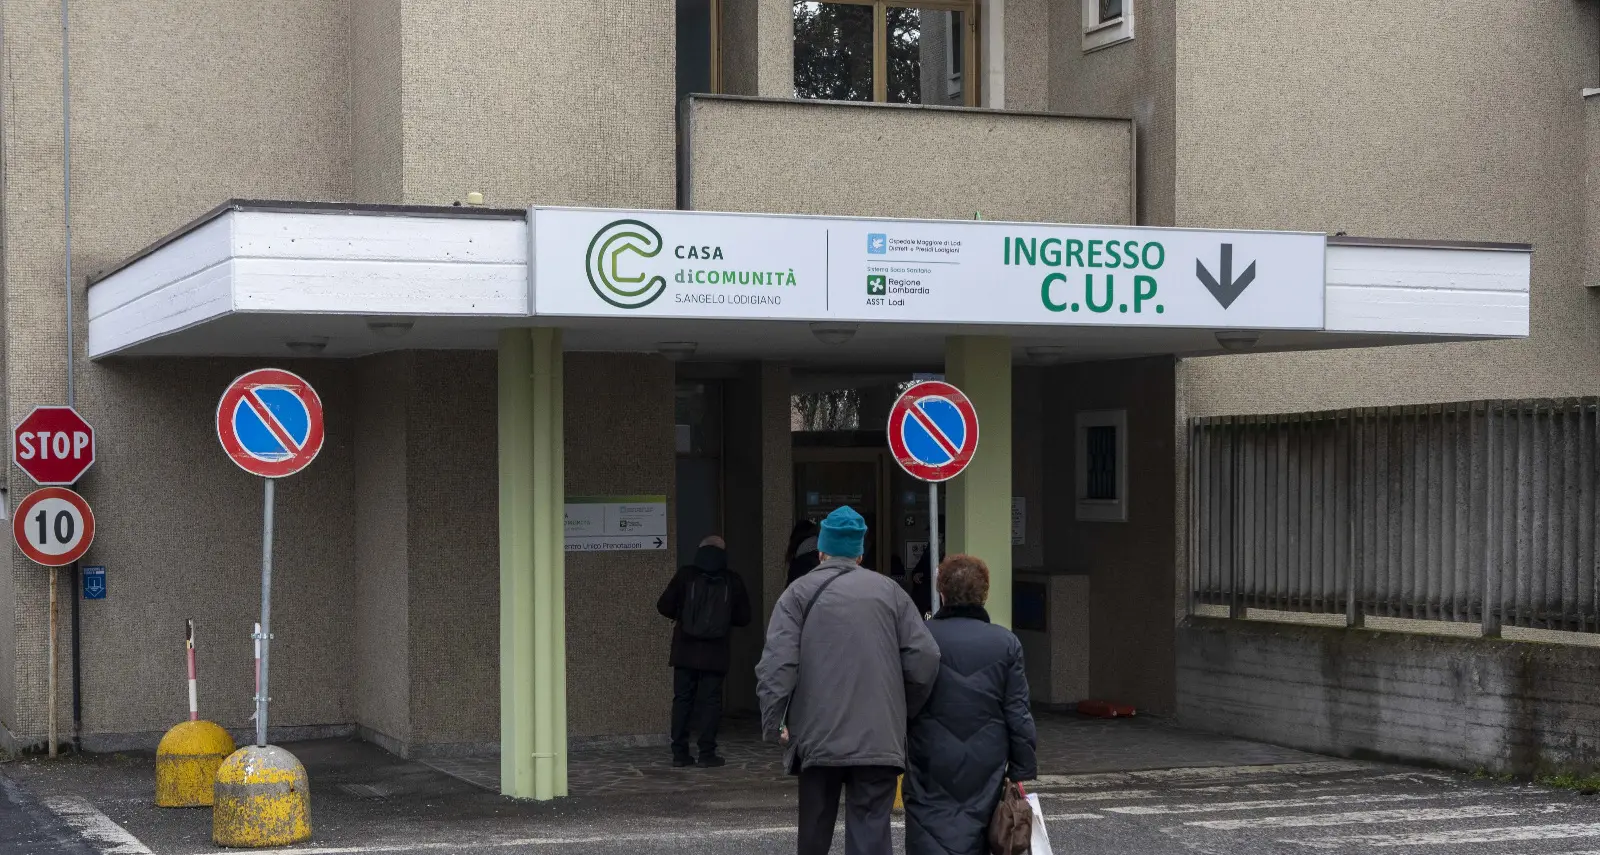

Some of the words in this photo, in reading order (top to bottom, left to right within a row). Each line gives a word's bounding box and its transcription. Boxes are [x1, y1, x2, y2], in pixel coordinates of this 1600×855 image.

[888, 238, 916, 246] Ospedale
[916, 239, 942, 247] Maggiore
[674, 245, 724, 260] CASA
[1004, 236, 1165, 270] INGRESSO
[674, 268, 797, 286] diCOMUNITÀ
[888, 278, 921, 287] Regione
[888, 286, 930, 295] Lombardia
[1040, 272, 1165, 314] C.U.P.
[675, 293, 725, 304] S.ANGELO
[727, 295, 781, 305] LODIGIANO
[866, 298, 885, 306] ASST
[888, 298, 905, 306] Lodi
[19, 431, 89, 460] STOP
[35, 510, 75, 545] 10
[564, 542, 582, 550] entro
[583, 541, 602, 550] Unico
[602, 541, 642, 549] Prenotazioni
